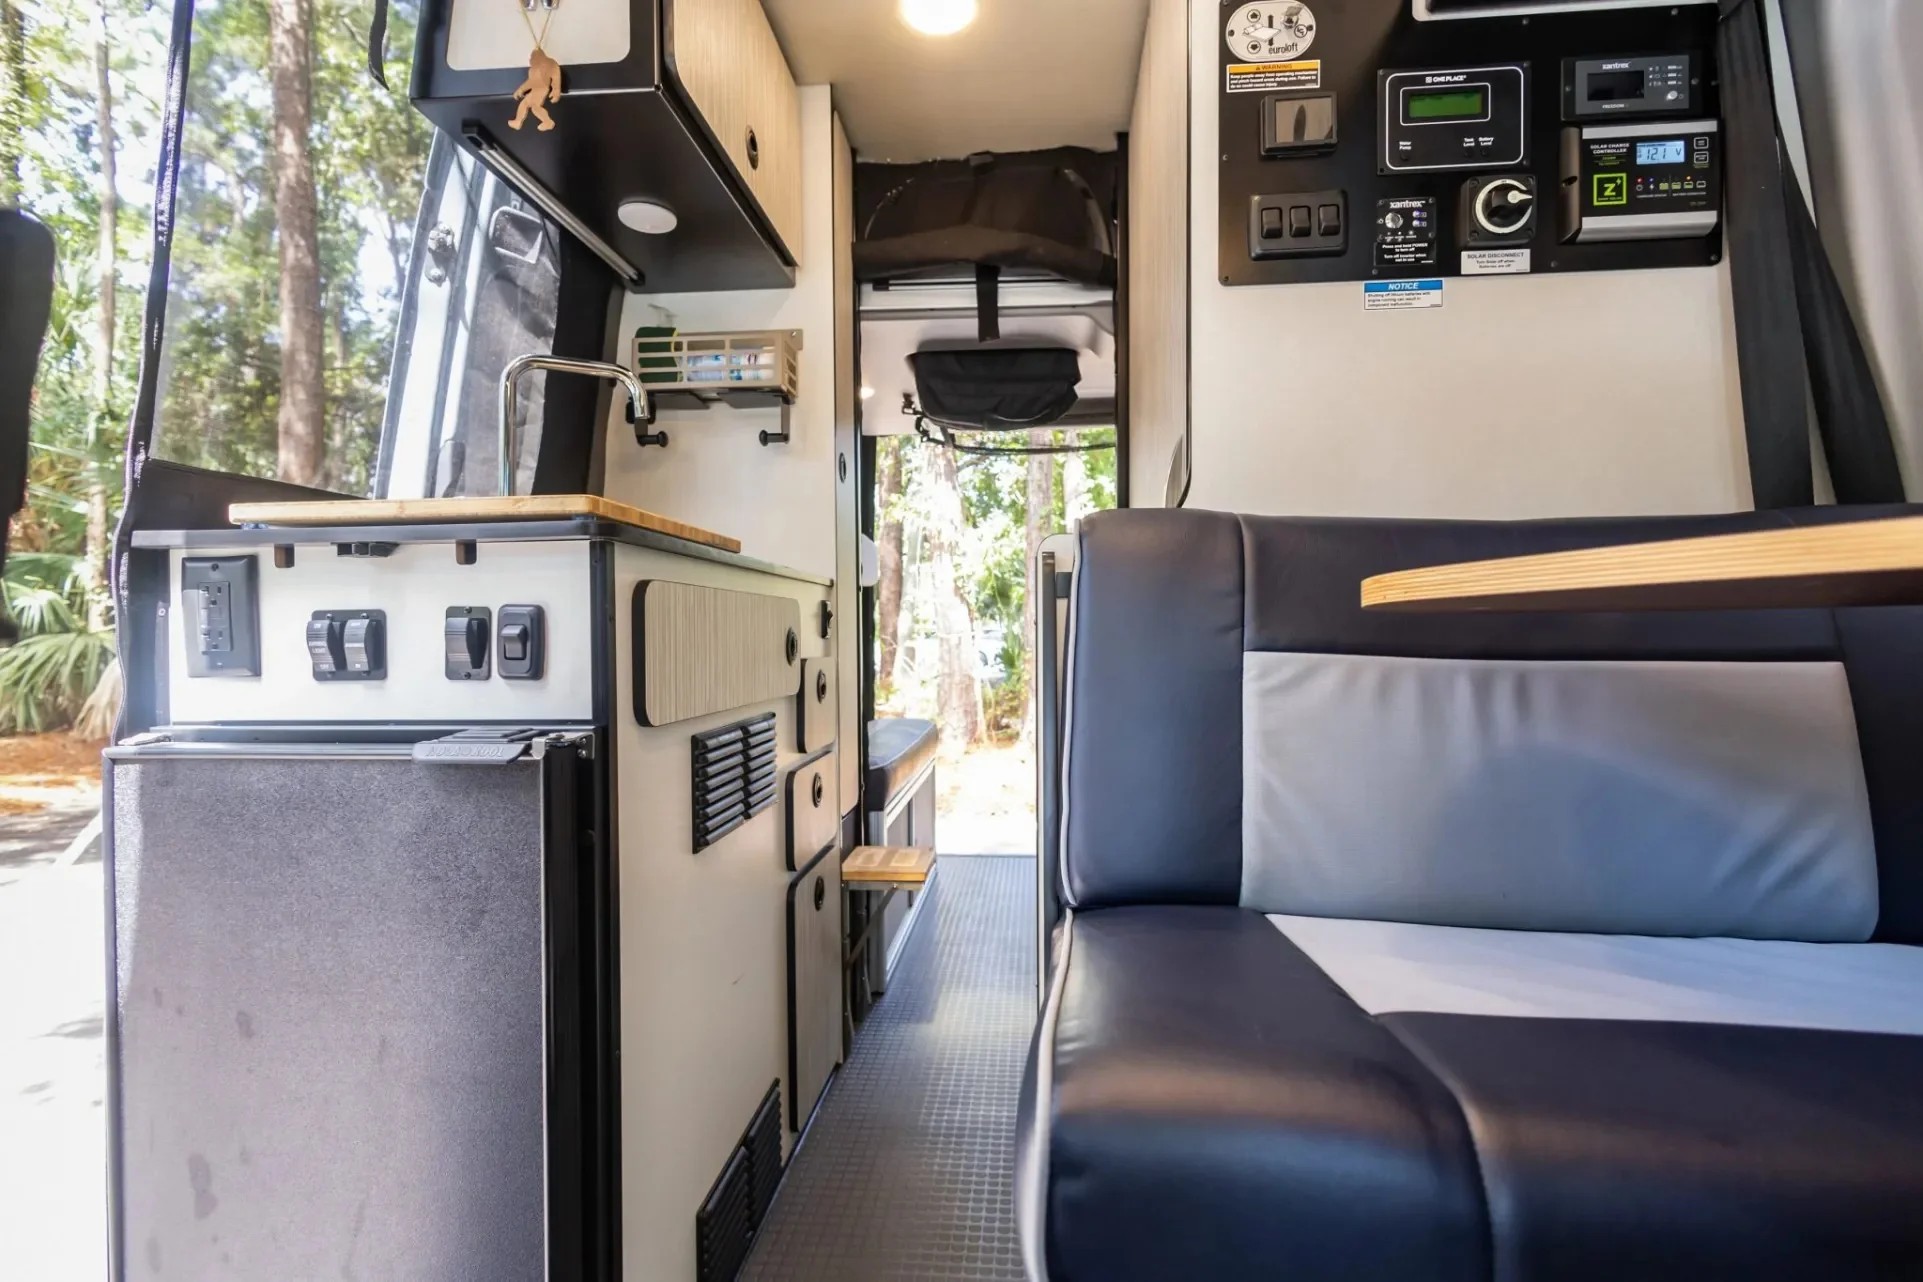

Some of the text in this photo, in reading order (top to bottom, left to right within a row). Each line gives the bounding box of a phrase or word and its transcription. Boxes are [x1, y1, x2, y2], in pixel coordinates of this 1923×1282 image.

[1268, 43, 1298, 54] euroloft
[1602, 62, 1629, 70] xantrex
[1390, 200, 1422, 209] xantrex
[1388, 282, 1419, 290] NOTICE
